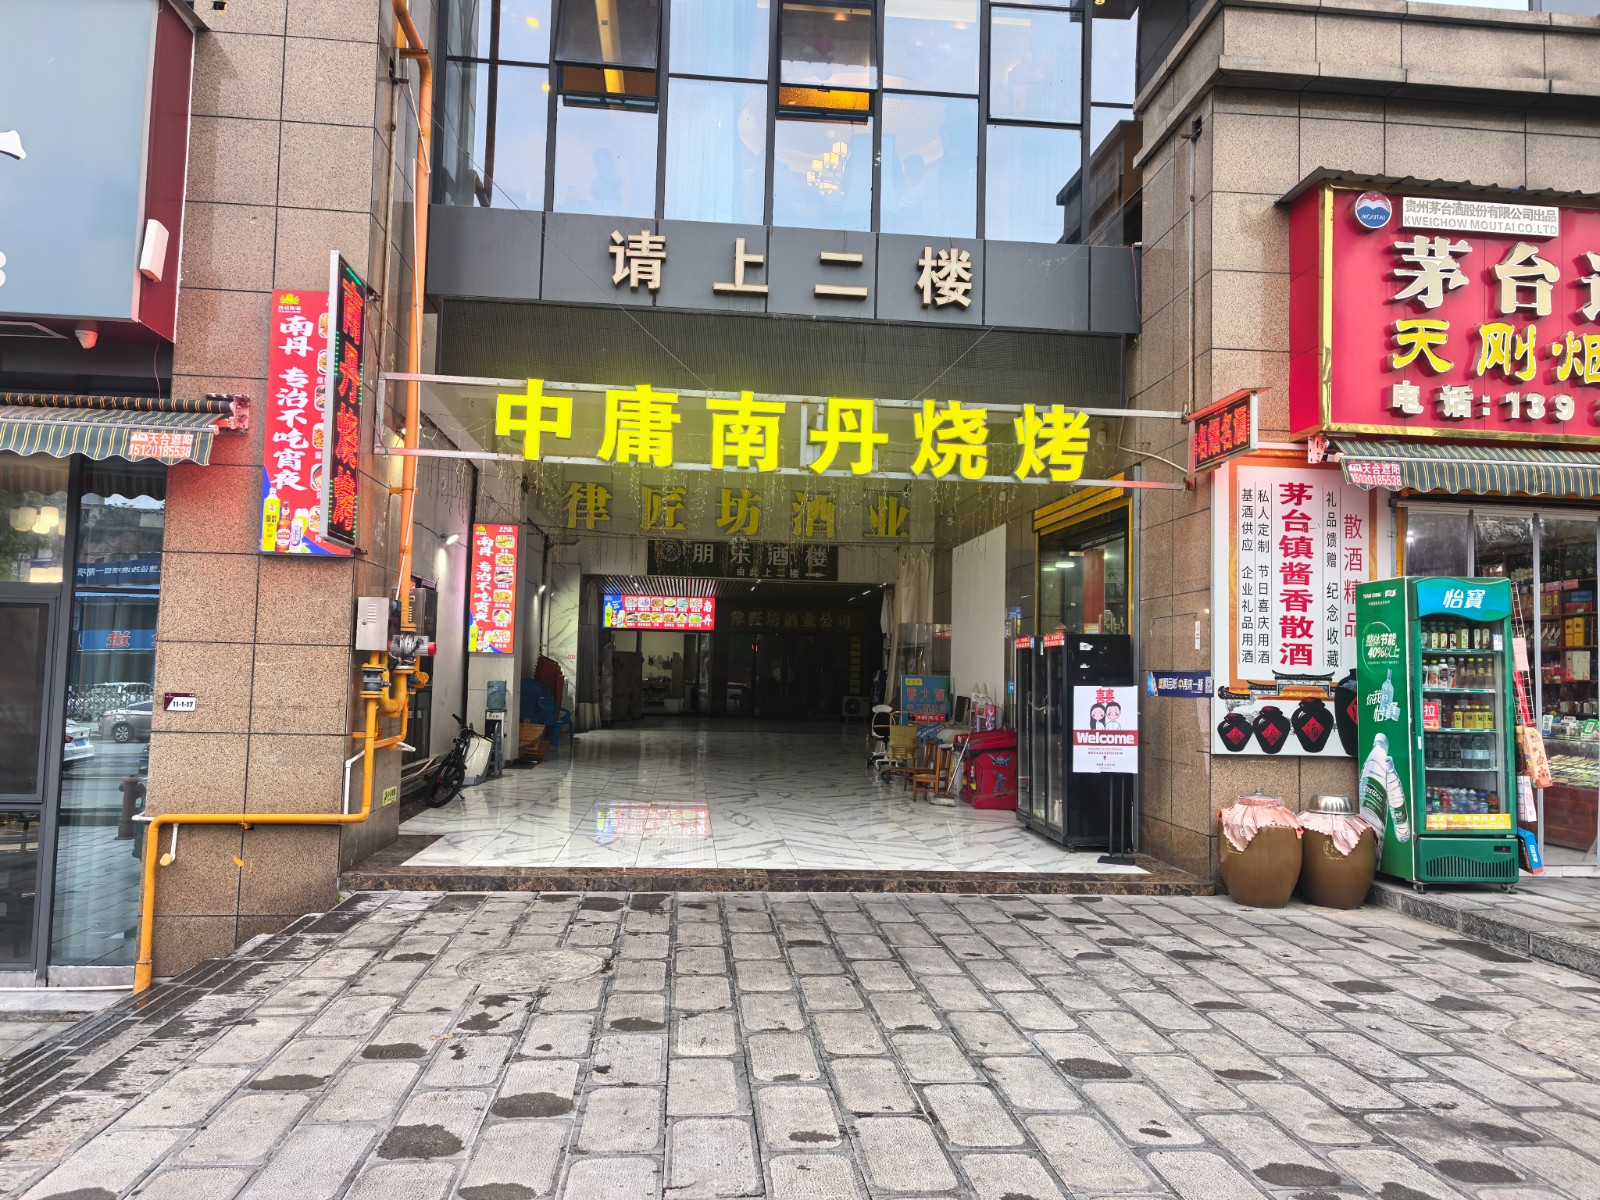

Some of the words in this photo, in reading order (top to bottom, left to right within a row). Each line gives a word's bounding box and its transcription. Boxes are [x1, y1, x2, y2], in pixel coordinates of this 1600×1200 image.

[1361, 213, 1386, 221] MOUTAI
[1403, 215, 1468, 227] KWEICHOW
[1470, 219, 1515, 232] MOUTAI
[1517, 224, 1558, 235] CO.LTD
[1404, 198, 1557, 223] 贵州茅台酒股份有限公司出品
[608, 229, 973, 308] 请上二楼
[1394, 235, 1600, 321] 茅台
[278, 314, 315, 357] 南丹
[128, 444, 192, 458] 15120185538
[148, 433, 194, 446] 天合遮阳
[271, 366, 310, 491] 专治不吃宵夜
[495, 377, 1091, 483] 中庸南丹烧烤
[1350, 473, 1403, 486] 15120185538
[1363, 463, 1401, 475] 天合遮阳
[562, 483, 911, 539] 律匠坊酒业
[1241, 488, 1254, 551] 基酒供应
[1257, 489, 1270, 553] 私人定制
[1326, 491, 1337, 568] 礼品馈赠
[1278, 482, 1315, 667] 茅台镇酱香散酒
[1441, 587, 1487, 611] 怡寶
[1241, 565, 1254, 664] 企业礼品用酒
[1257, 564, 1270, 665] 节日喜庆用酒
[1326, 582, 1339, 668] 纪念收藏
[1076, 731, 1135, 745] Welcome
[1424, 704, 1437, 717] 拉
